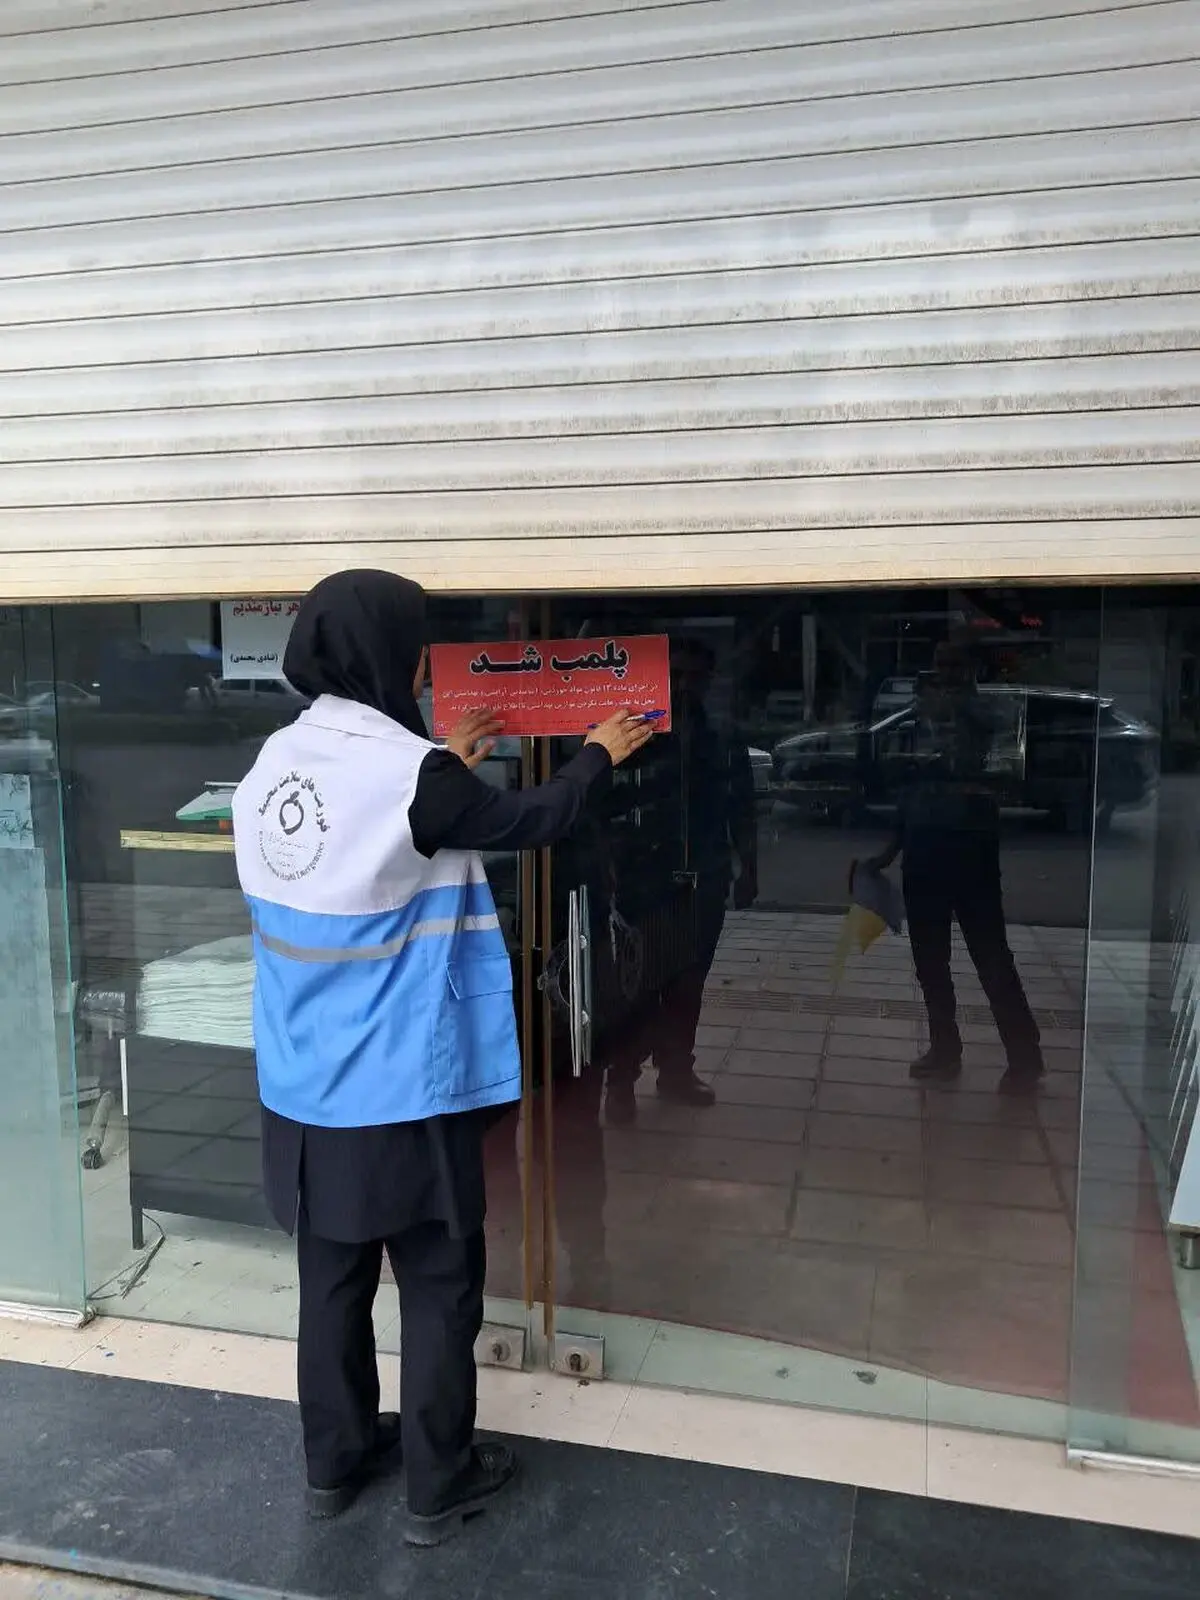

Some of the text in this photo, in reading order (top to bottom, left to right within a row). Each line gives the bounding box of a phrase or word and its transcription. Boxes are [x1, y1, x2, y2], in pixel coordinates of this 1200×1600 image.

[470, 640, 628, 681] پلمب شد
[279, 770, 301, 788] سلامت
[301, 777, 315, 792] های
